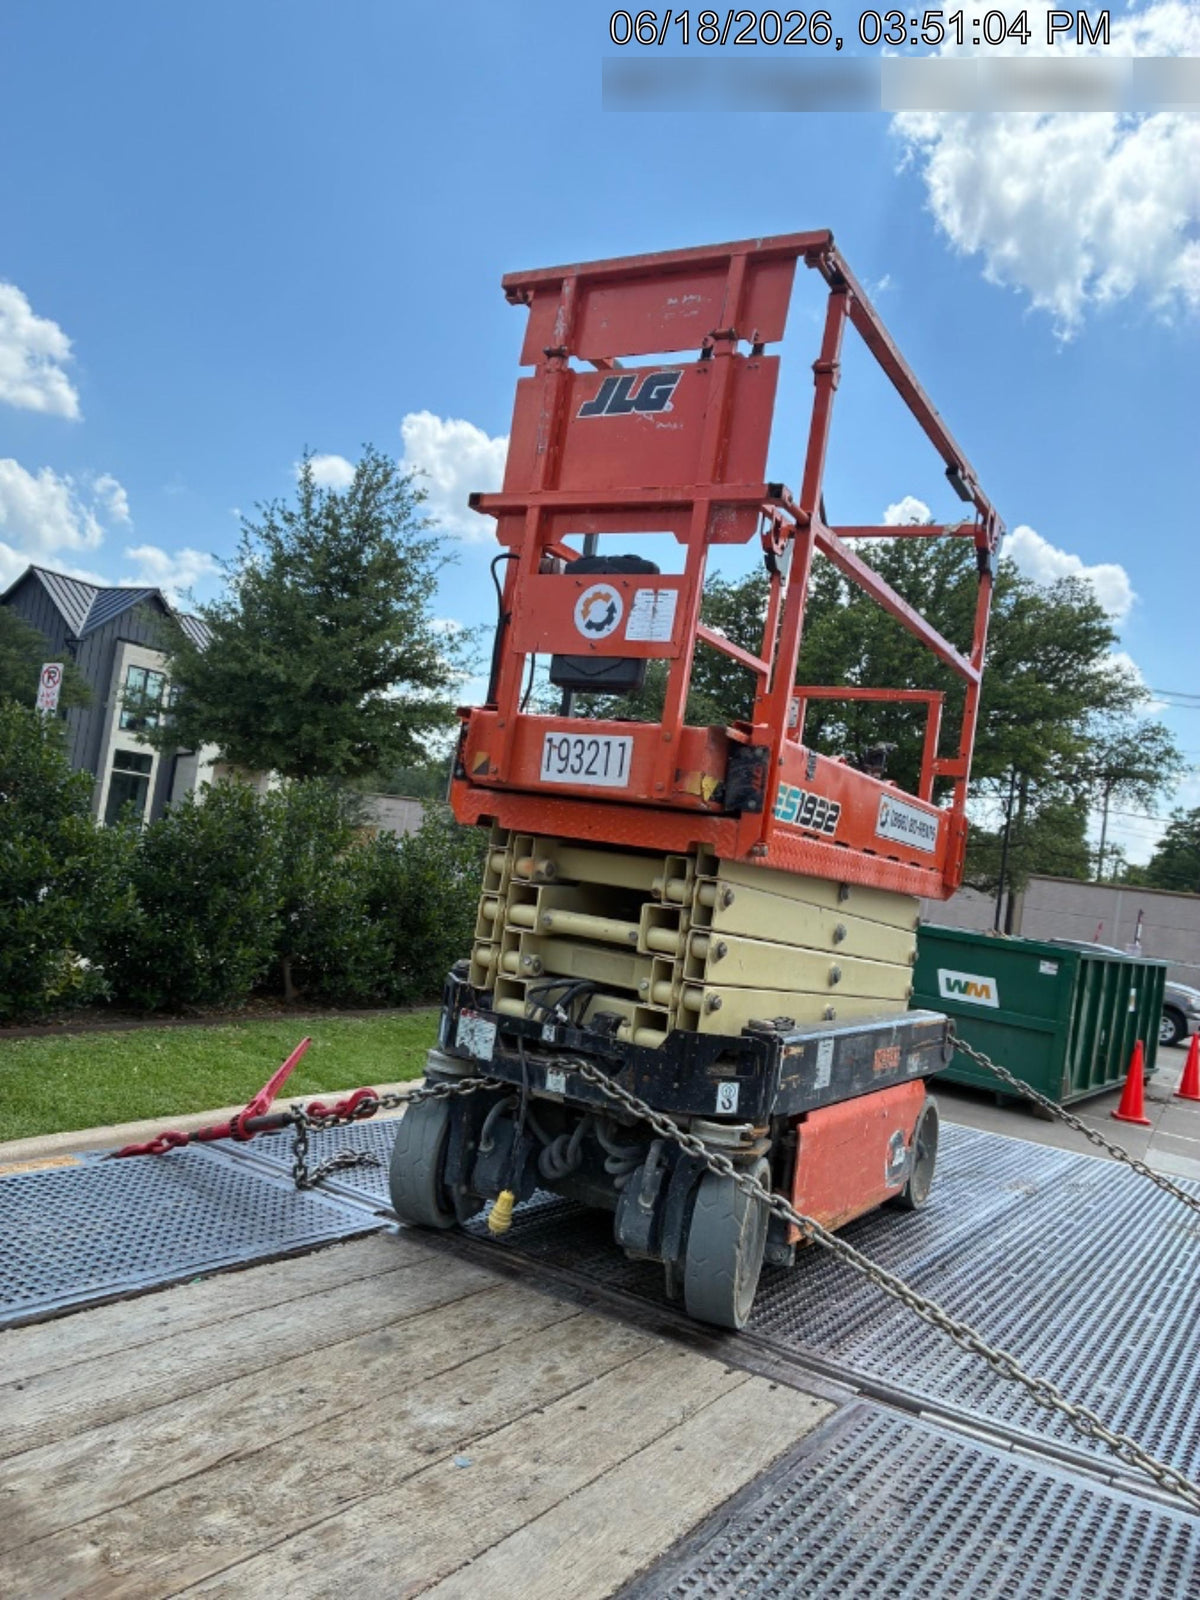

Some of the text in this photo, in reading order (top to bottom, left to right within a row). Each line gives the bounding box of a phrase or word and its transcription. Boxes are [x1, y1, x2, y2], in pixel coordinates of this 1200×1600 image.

[576, 369, 685, 418] JLG
[545, 737, 627, 778] 193211
[775, 782, 841, 836] ES1932
[945, 977, 991, 999] WM
